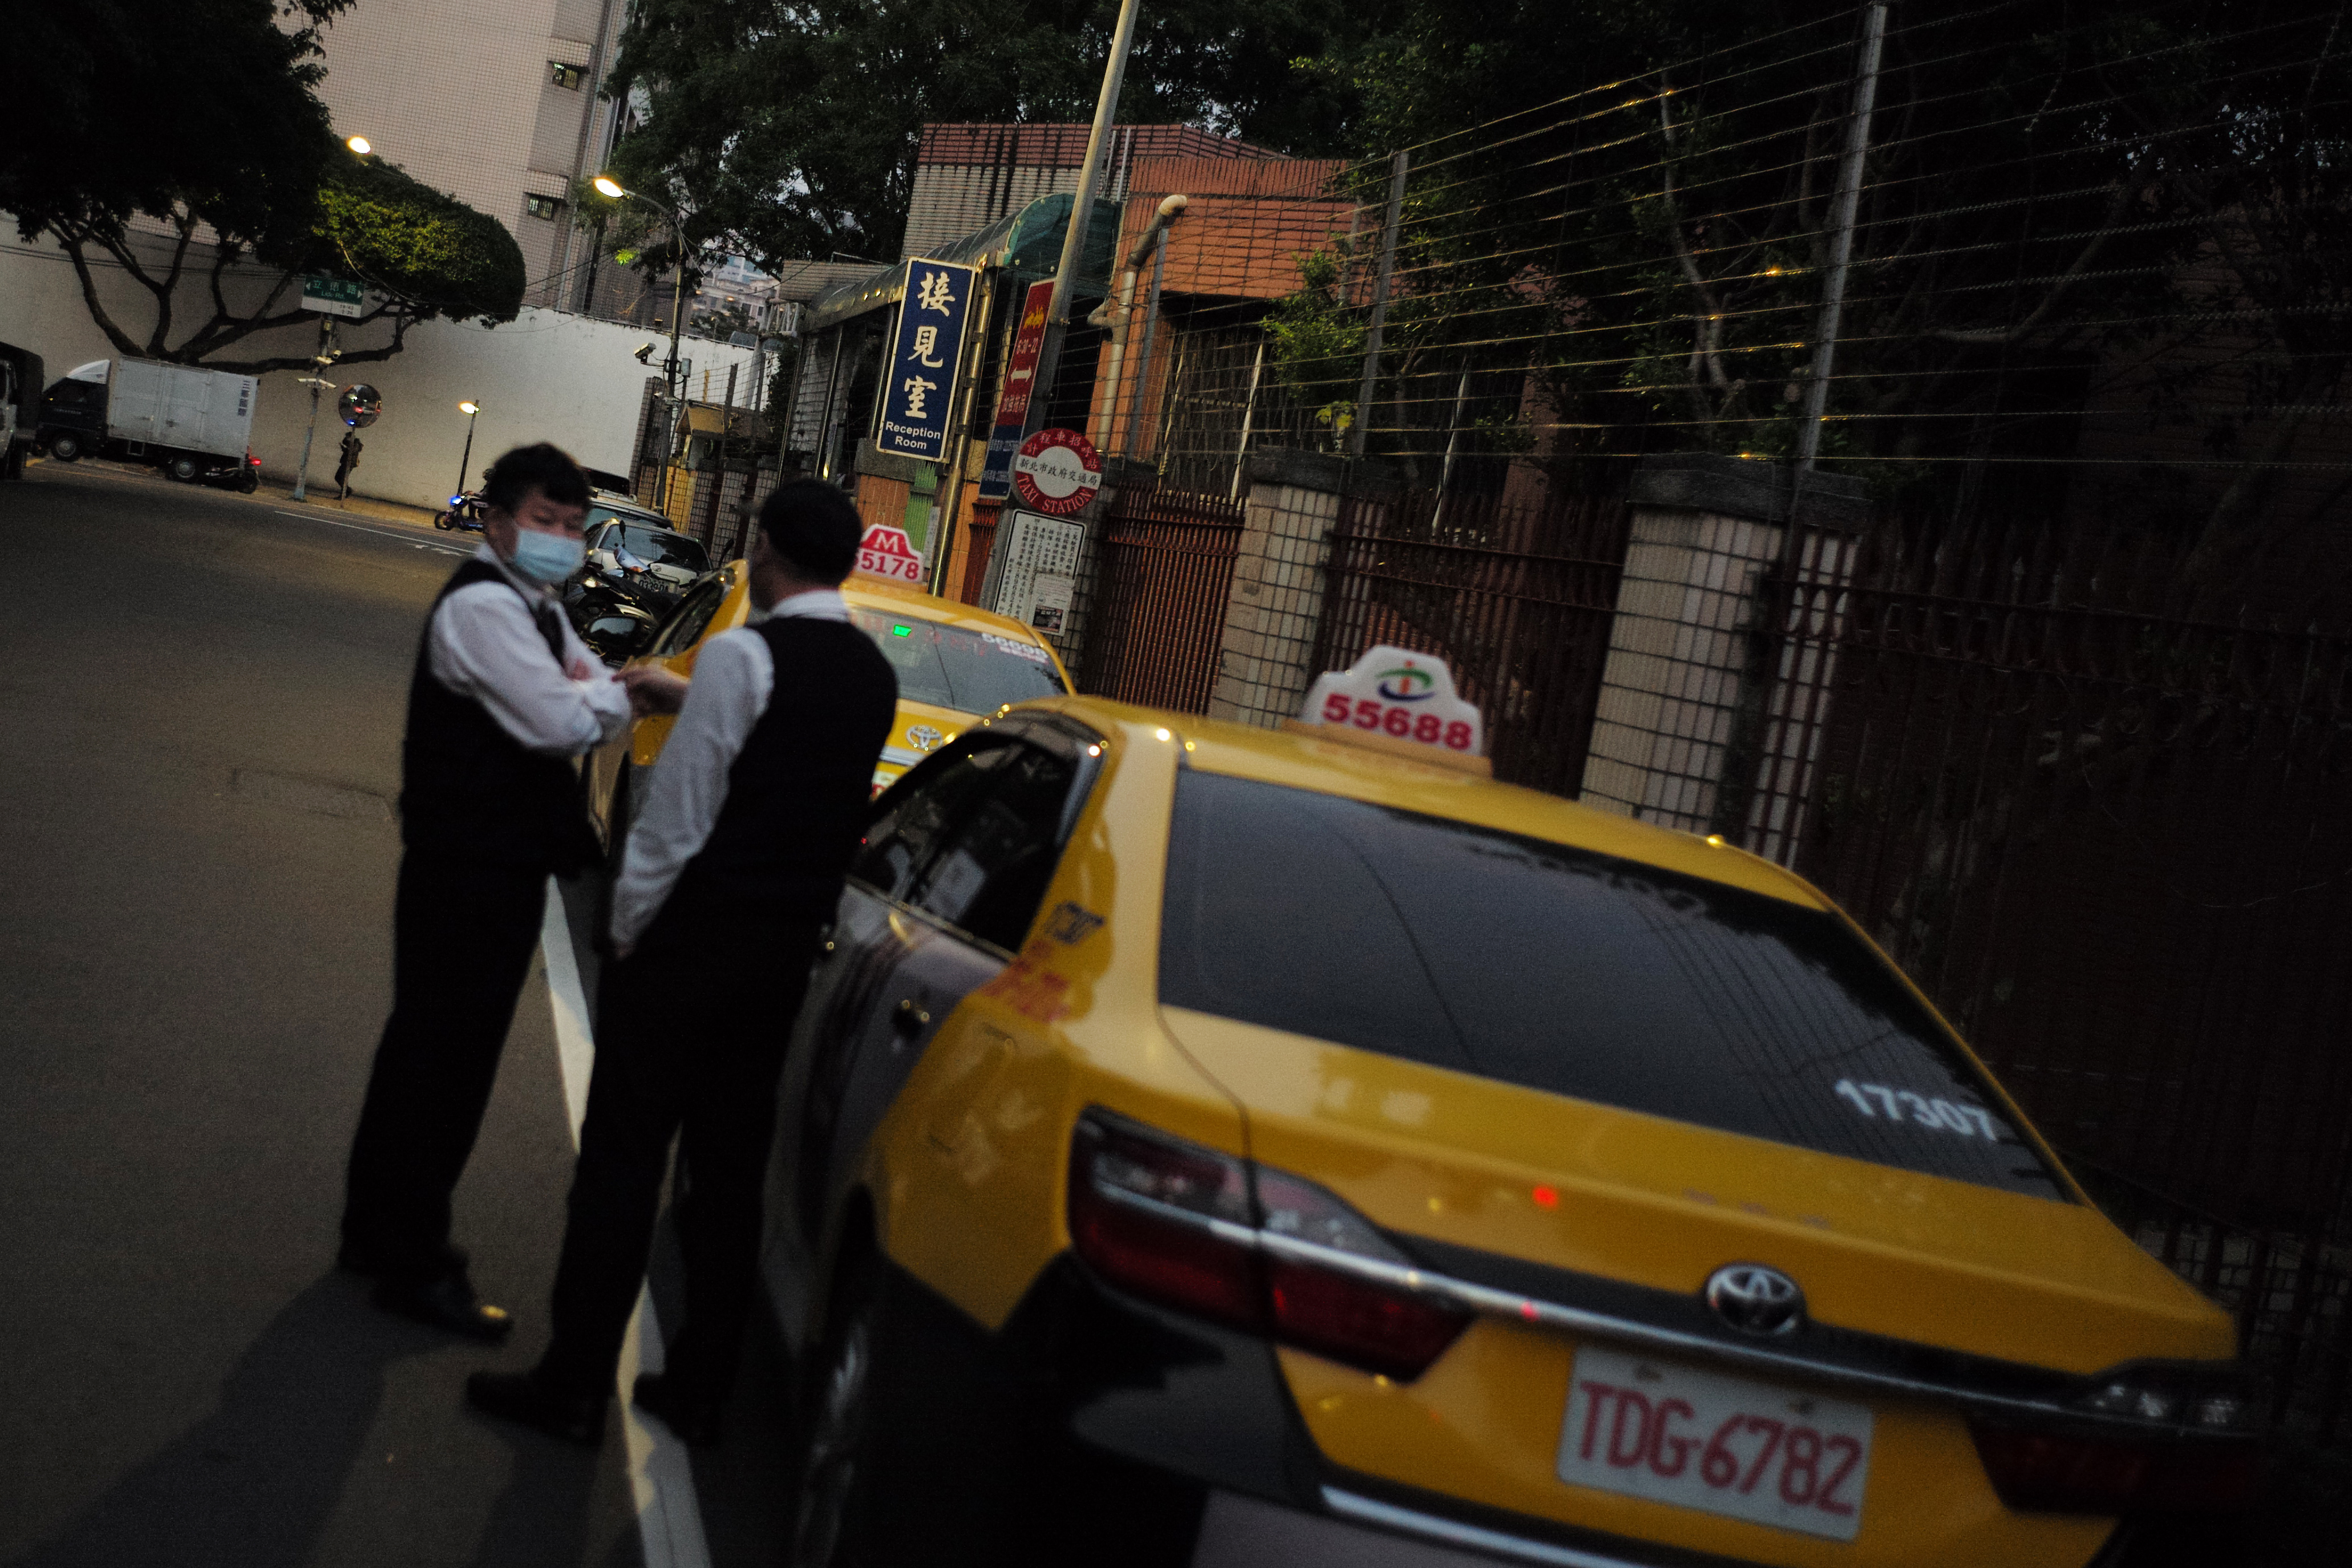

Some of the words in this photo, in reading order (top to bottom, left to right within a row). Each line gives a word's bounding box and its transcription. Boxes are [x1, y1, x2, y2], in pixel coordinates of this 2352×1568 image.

[904, 272, 956, 419] 接見室
[885, 421, 941, 439] Reception
[894, 435, 928, 450] Room
[1027, 430, 1098, 469] 計程車招呼站
[1019, 458, 1098, 485] 新北市政府交通局
[1017, 475, 1039, 503] TAXI
[1042, 489, 1093, 514] STATION
[873, 532, 900, 553] M
[855, 552, 919, 580] 5178
[1322, 692, 1472, 751] 55688
[1834, 1078, 1997, 1141] 17307
[1580, 1379, 1863, 1516] TDG-6782
